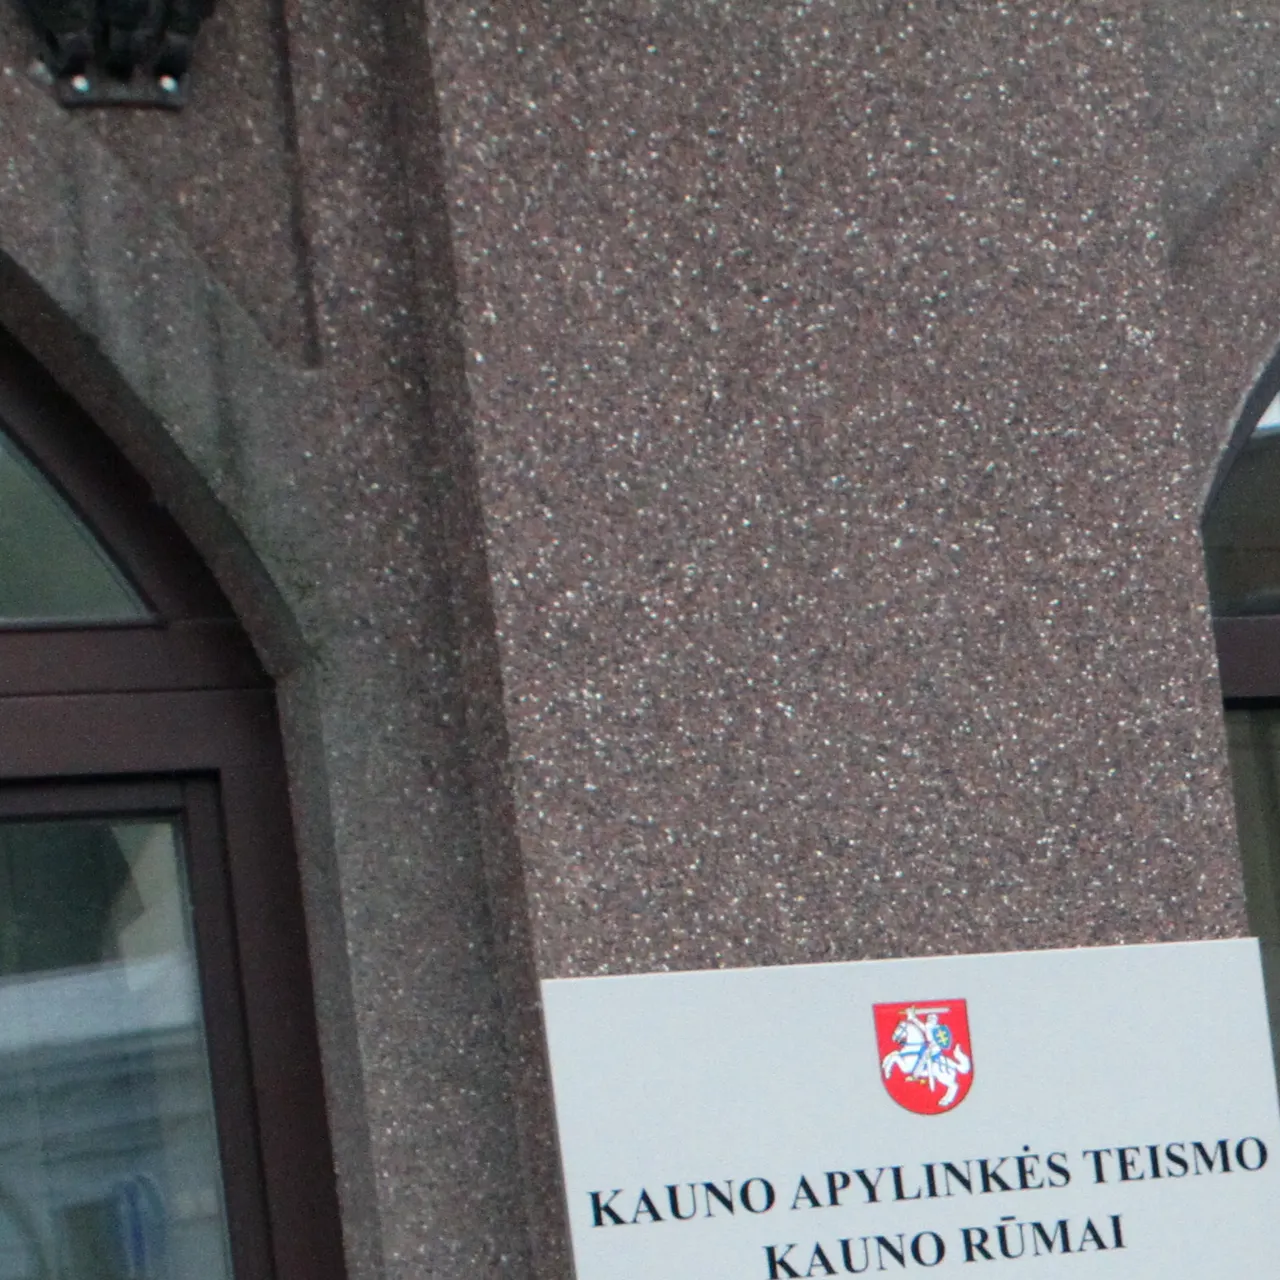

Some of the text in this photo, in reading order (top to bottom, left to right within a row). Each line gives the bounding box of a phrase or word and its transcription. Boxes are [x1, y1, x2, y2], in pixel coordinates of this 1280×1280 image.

[588, 1136, 1269, 1228] KAUNO APYLINKĖS TEISMO
[764, 1215, 1128, 1280] KAUNO RŪMAI
